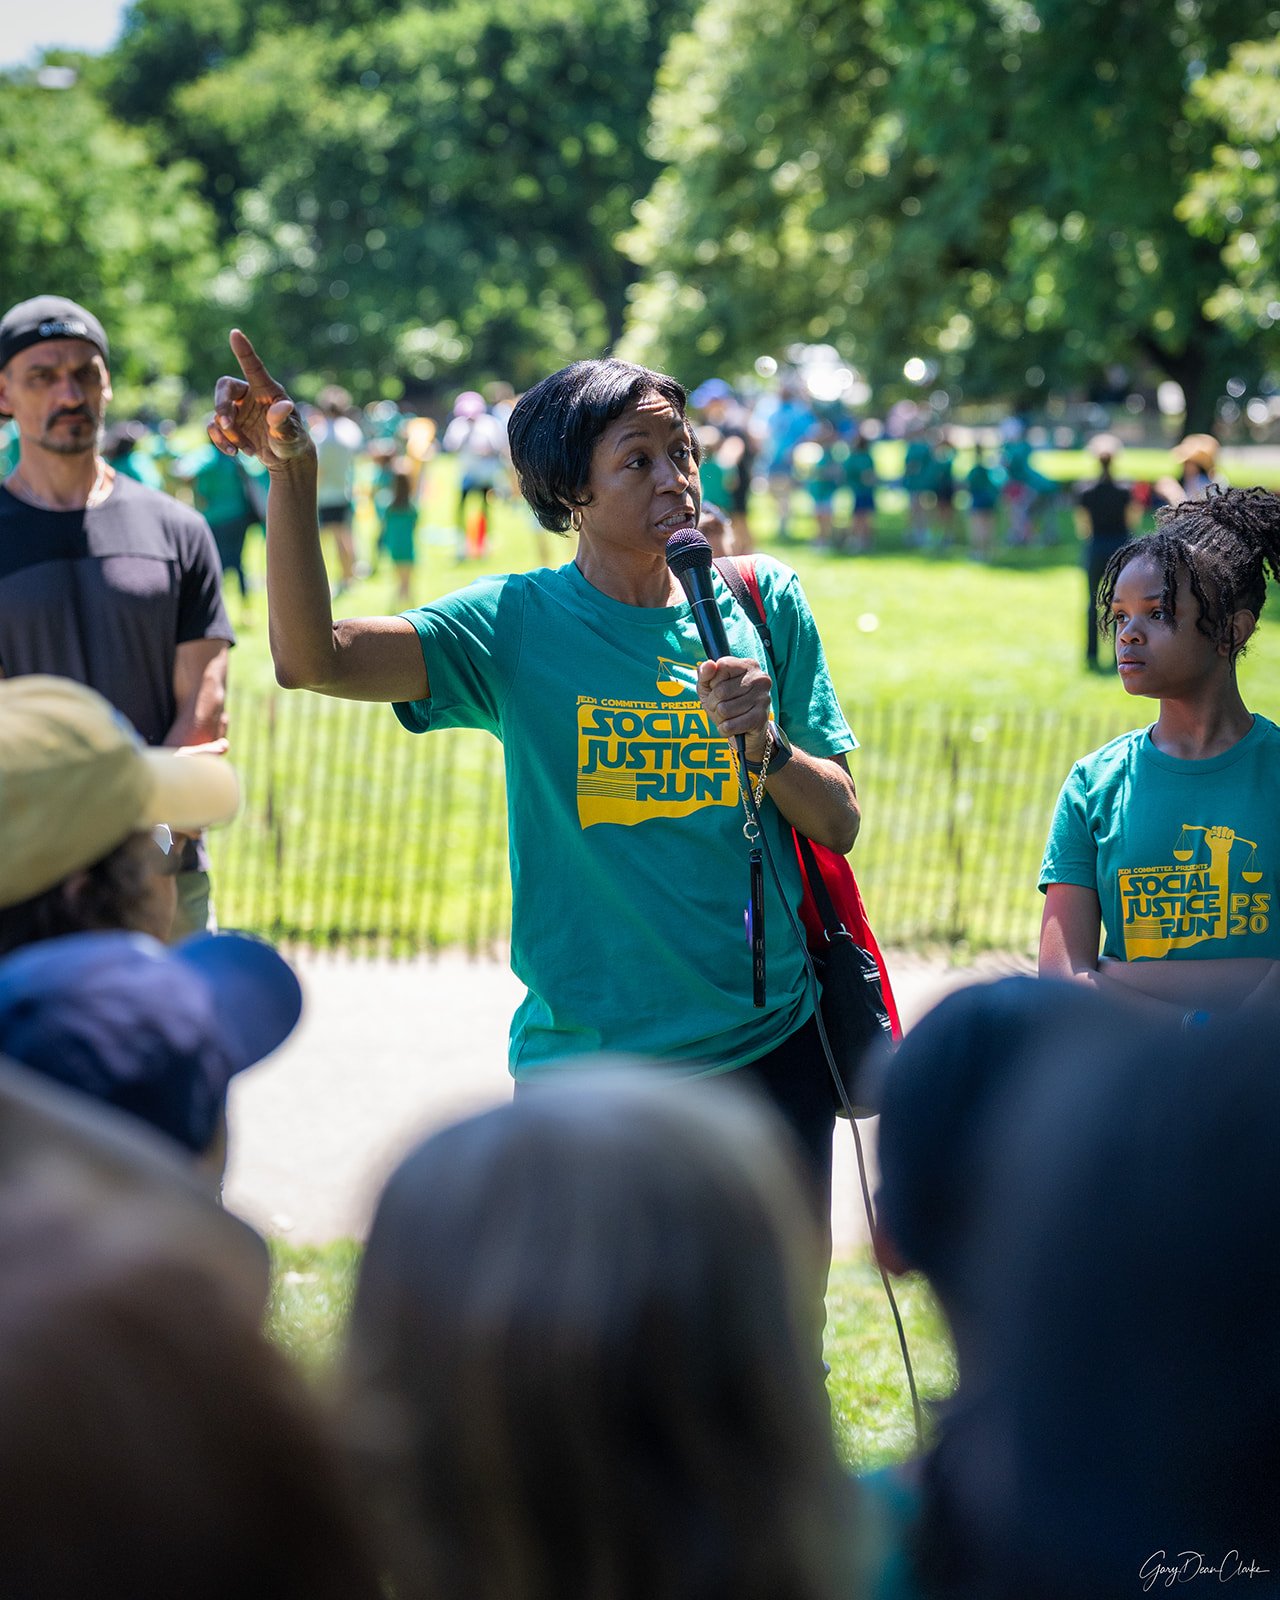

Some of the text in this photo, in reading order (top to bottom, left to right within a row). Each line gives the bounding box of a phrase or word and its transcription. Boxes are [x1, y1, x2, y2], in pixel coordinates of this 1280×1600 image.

[576, 695, 703, 710] JEDI COMMITTEE PRESEN
[582, 740, 731, 774] JUSTICE
[635, 772, 731, 801] RUN
[1133, 865, 1173, 874] COMMITTEE
[1175, 864, 1209, 872] PRESENTS
[1123, 872, 1220, 896] SOCIAL
[1125, 894, 1221, 924] JUSTICE
[1230, 893, 1272, 914] PS
[1159, 915, 1221, 938] RUN
[1229, 913, 1269, 936] 20
